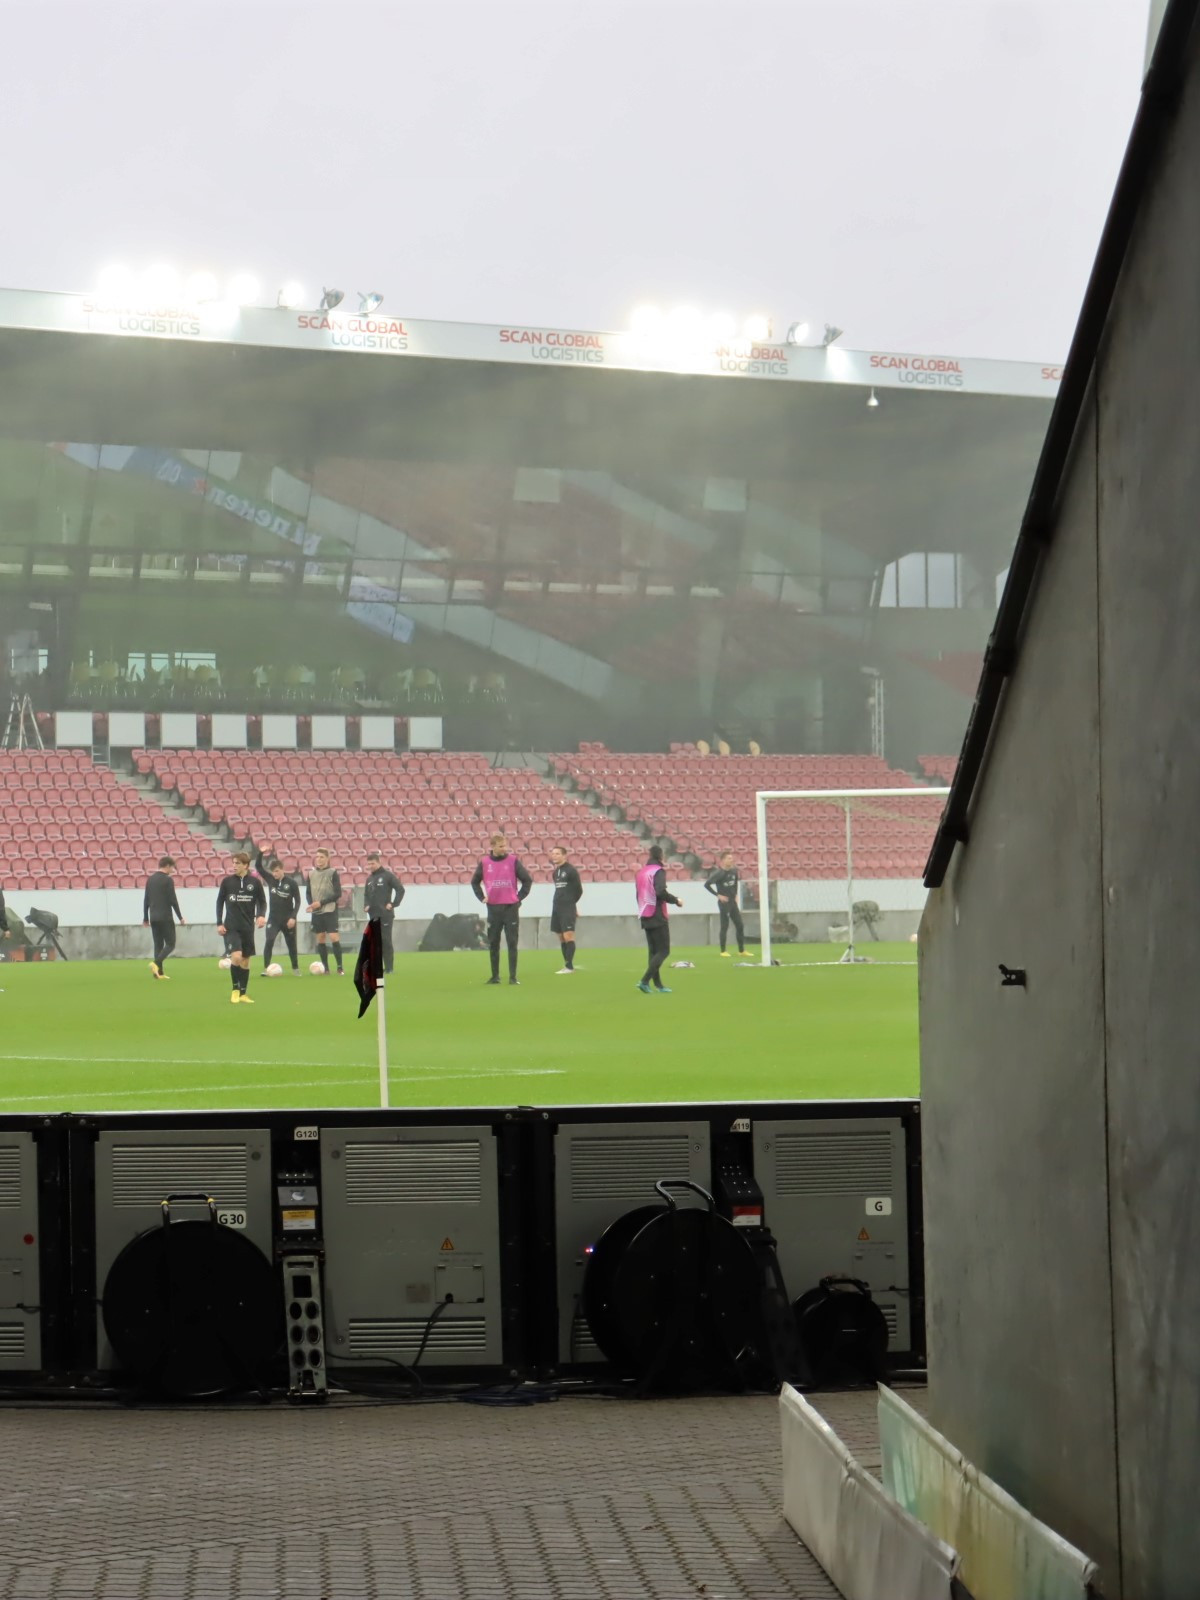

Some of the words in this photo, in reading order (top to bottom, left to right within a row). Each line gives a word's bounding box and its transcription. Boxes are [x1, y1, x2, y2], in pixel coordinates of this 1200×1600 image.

[119, 318, 200, 335] LOGISTICS
[298, 316, 342, 330] SCAN
[348, 320, 407, 335] GLOBAL
[332, 333, 408, 349] LOGISTICS
[500, 330, 542, 344] SCAN
[546, 333, 603, 348] GLOBAL
[532, 346, 604, 362] LOGISTICS
[720, 359, 788, 375] LOGISTICS
[870, 356, 907, 369] SCAN
[911, 358, 962, 373] GLOBAL
[898, 371, 963, 386] LOGISTICS
[296, 1130, 317, 1138] G120
[874, 1201, 883, 1212] G
